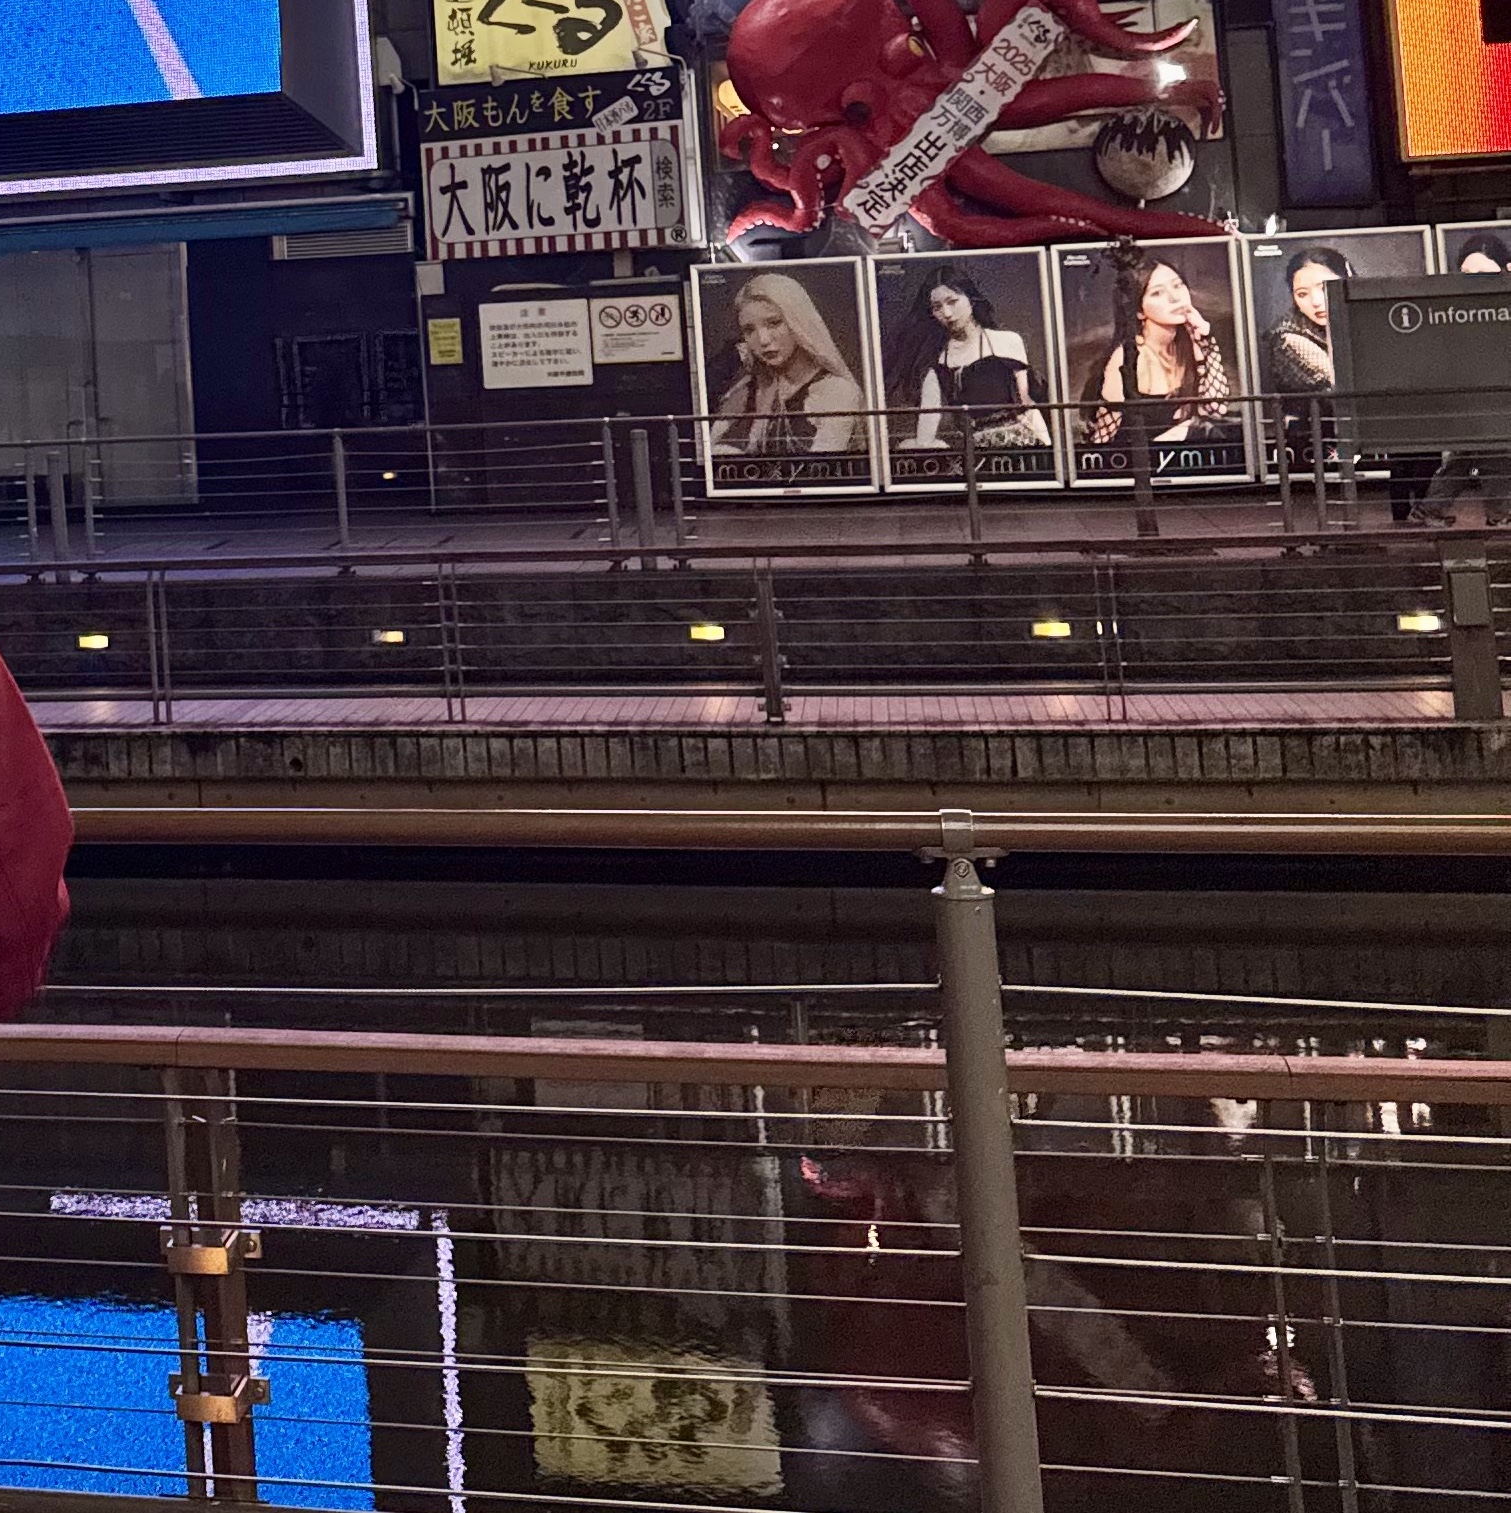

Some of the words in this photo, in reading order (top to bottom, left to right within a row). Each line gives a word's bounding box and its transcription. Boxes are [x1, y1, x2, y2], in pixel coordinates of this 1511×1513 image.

[529, 58, 578, 71] KUKURU
[992, 38, 1036, 76] 2025
[627, 71, 670, 96] くくる
[974, 60, 1016, 96] 大阪
[424, 85, 602, 133] 大阪もんを食す
[643, 98, 675, 120] 2F
[931, 105, 972, 142] 万博
[946, 87, 990, 125] 関西
[439, 148, 646, 238] 大阪に乾杯
[655, 155, 676, 209] 検索
[857, 131, 946, 220] 出店決定
[1428, 306, 1511, 325] informa
